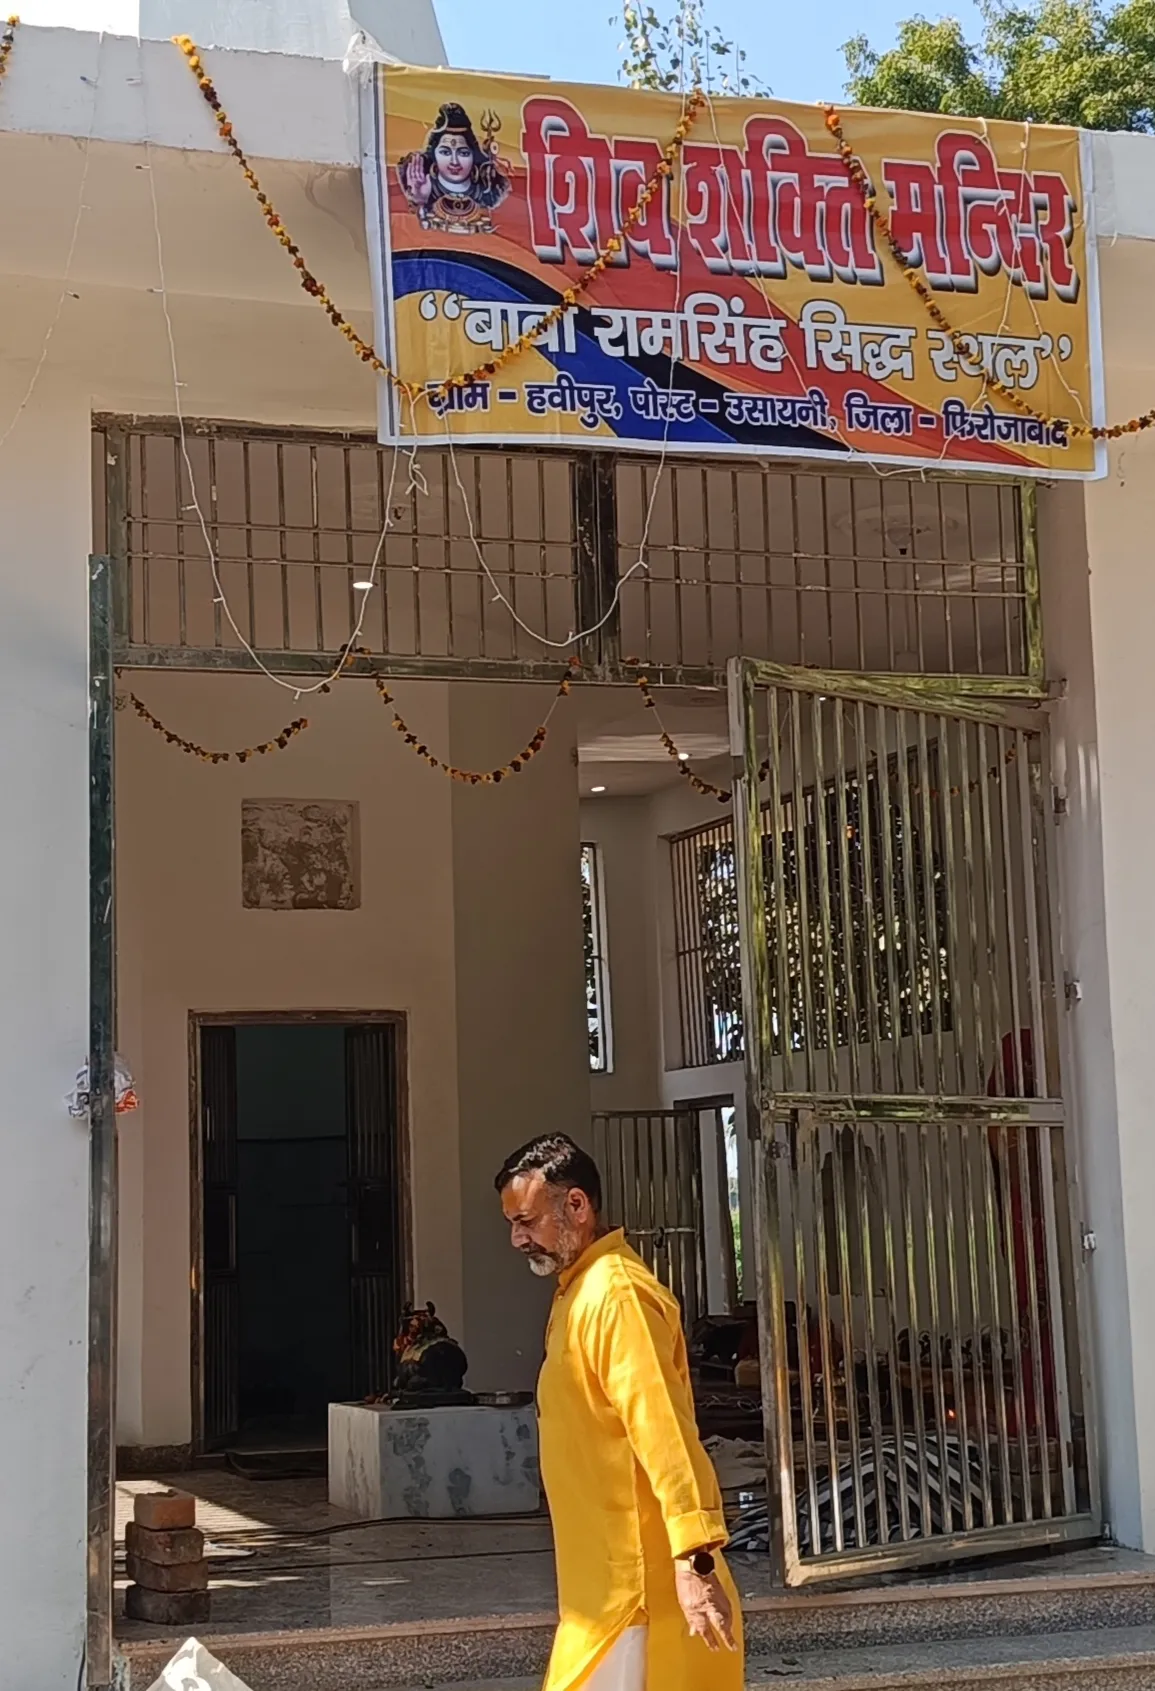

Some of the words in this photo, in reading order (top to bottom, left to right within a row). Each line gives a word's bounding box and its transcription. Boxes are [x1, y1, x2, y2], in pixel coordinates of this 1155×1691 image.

[521, 94, 680, 272] शिव
[682, 113, 885, 287] शक्ति
[882, 129, 1080, 304] मन्दिर
[590, 292, 786, 373] रामसिंह
[798, 298, 917, 382] सिद्ध
[629, 378, 696, 421] पोस्ट
[724, 386, 836, 432] उसायनी,
[845, 391, 912, 436] जिला
